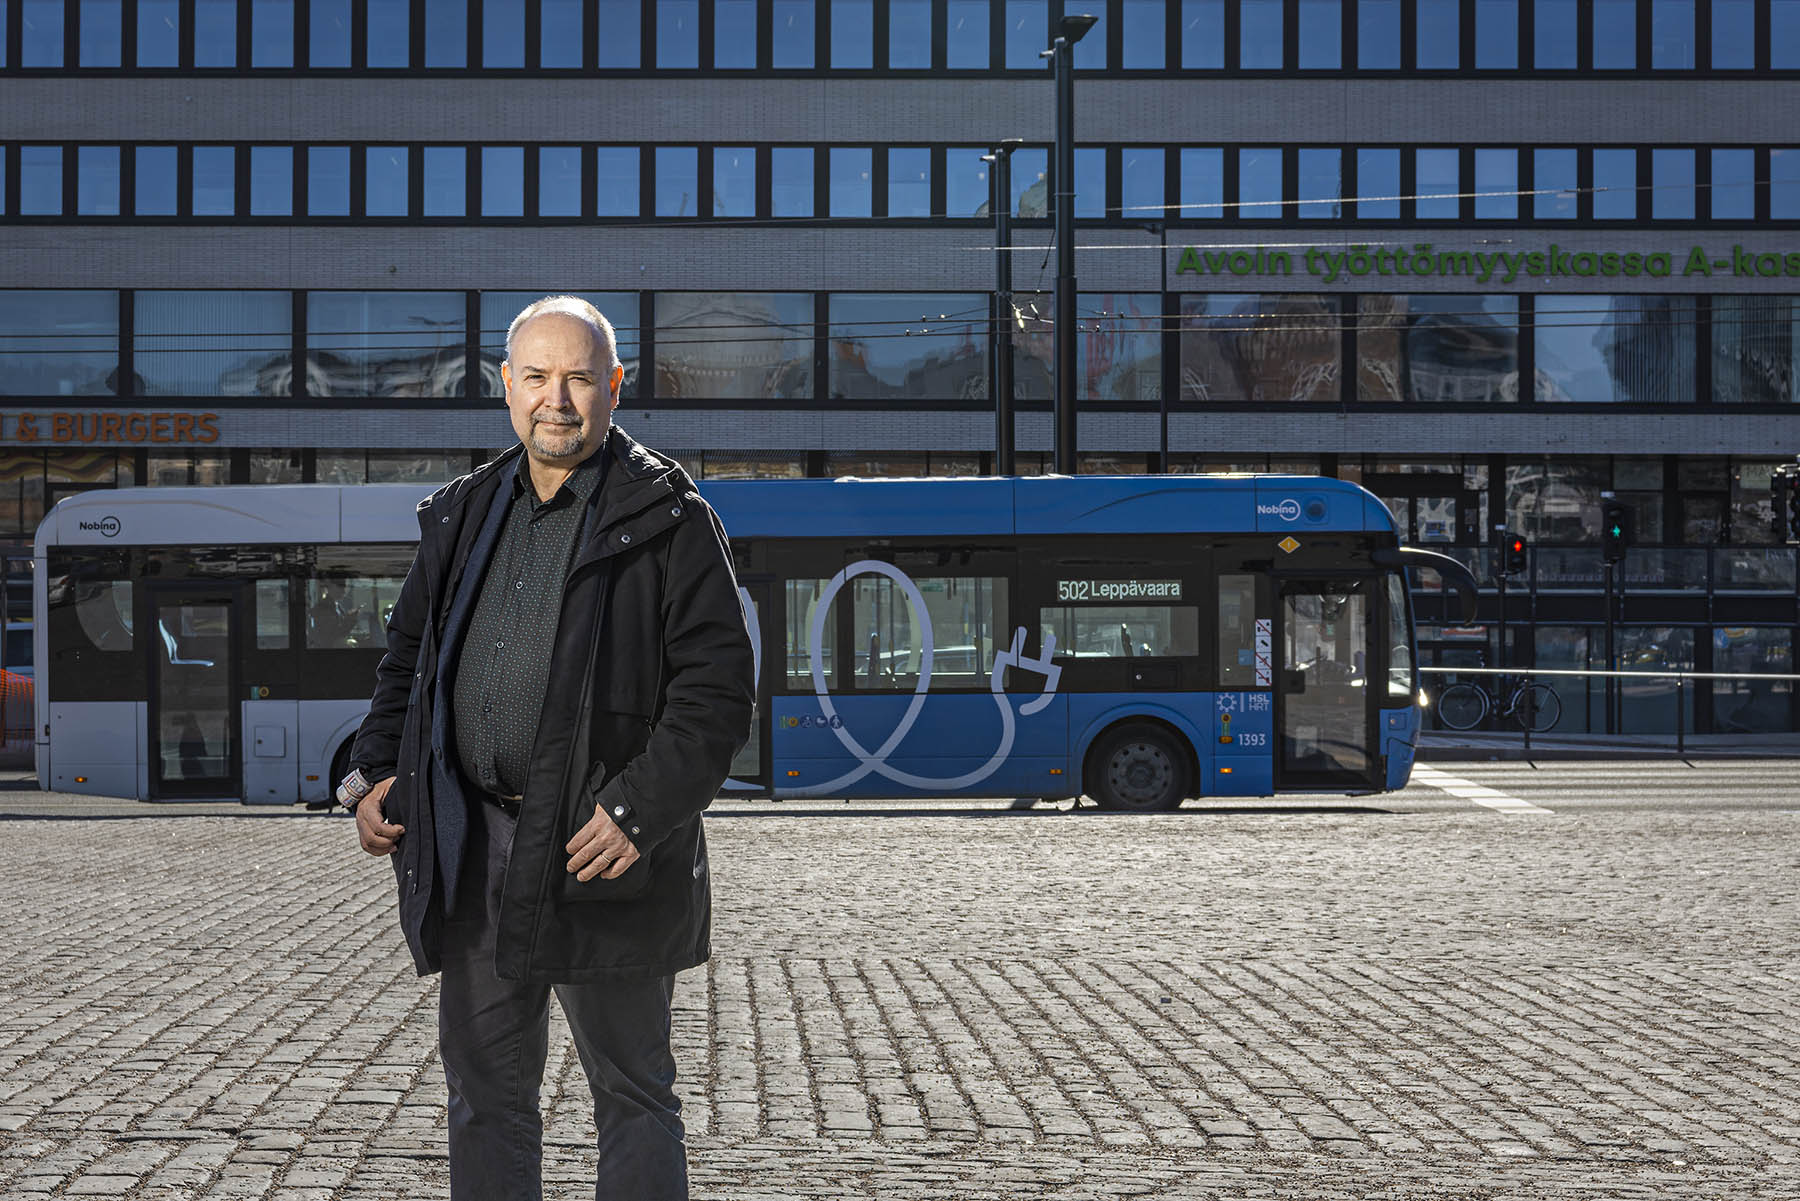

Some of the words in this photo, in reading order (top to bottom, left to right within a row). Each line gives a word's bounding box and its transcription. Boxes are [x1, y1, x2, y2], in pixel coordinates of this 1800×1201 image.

[1175, 245, 1293, 276] Avoin
[1303, 244, 1672, 284] työttömyyskassa
[1683, 245, 1800, 278] A-kas
[16, 413, 39, 442] &
[52, 413, 220, 443] BURGERS
[1059, 580, 1089, 600] 502
[1091, 580, 1180, 600] Leppävaara
[1248, 694, 1270, 702] HSL
[1248, 702, 1270, 711] HRT
[1238, 733, 1266, 746] 1393
